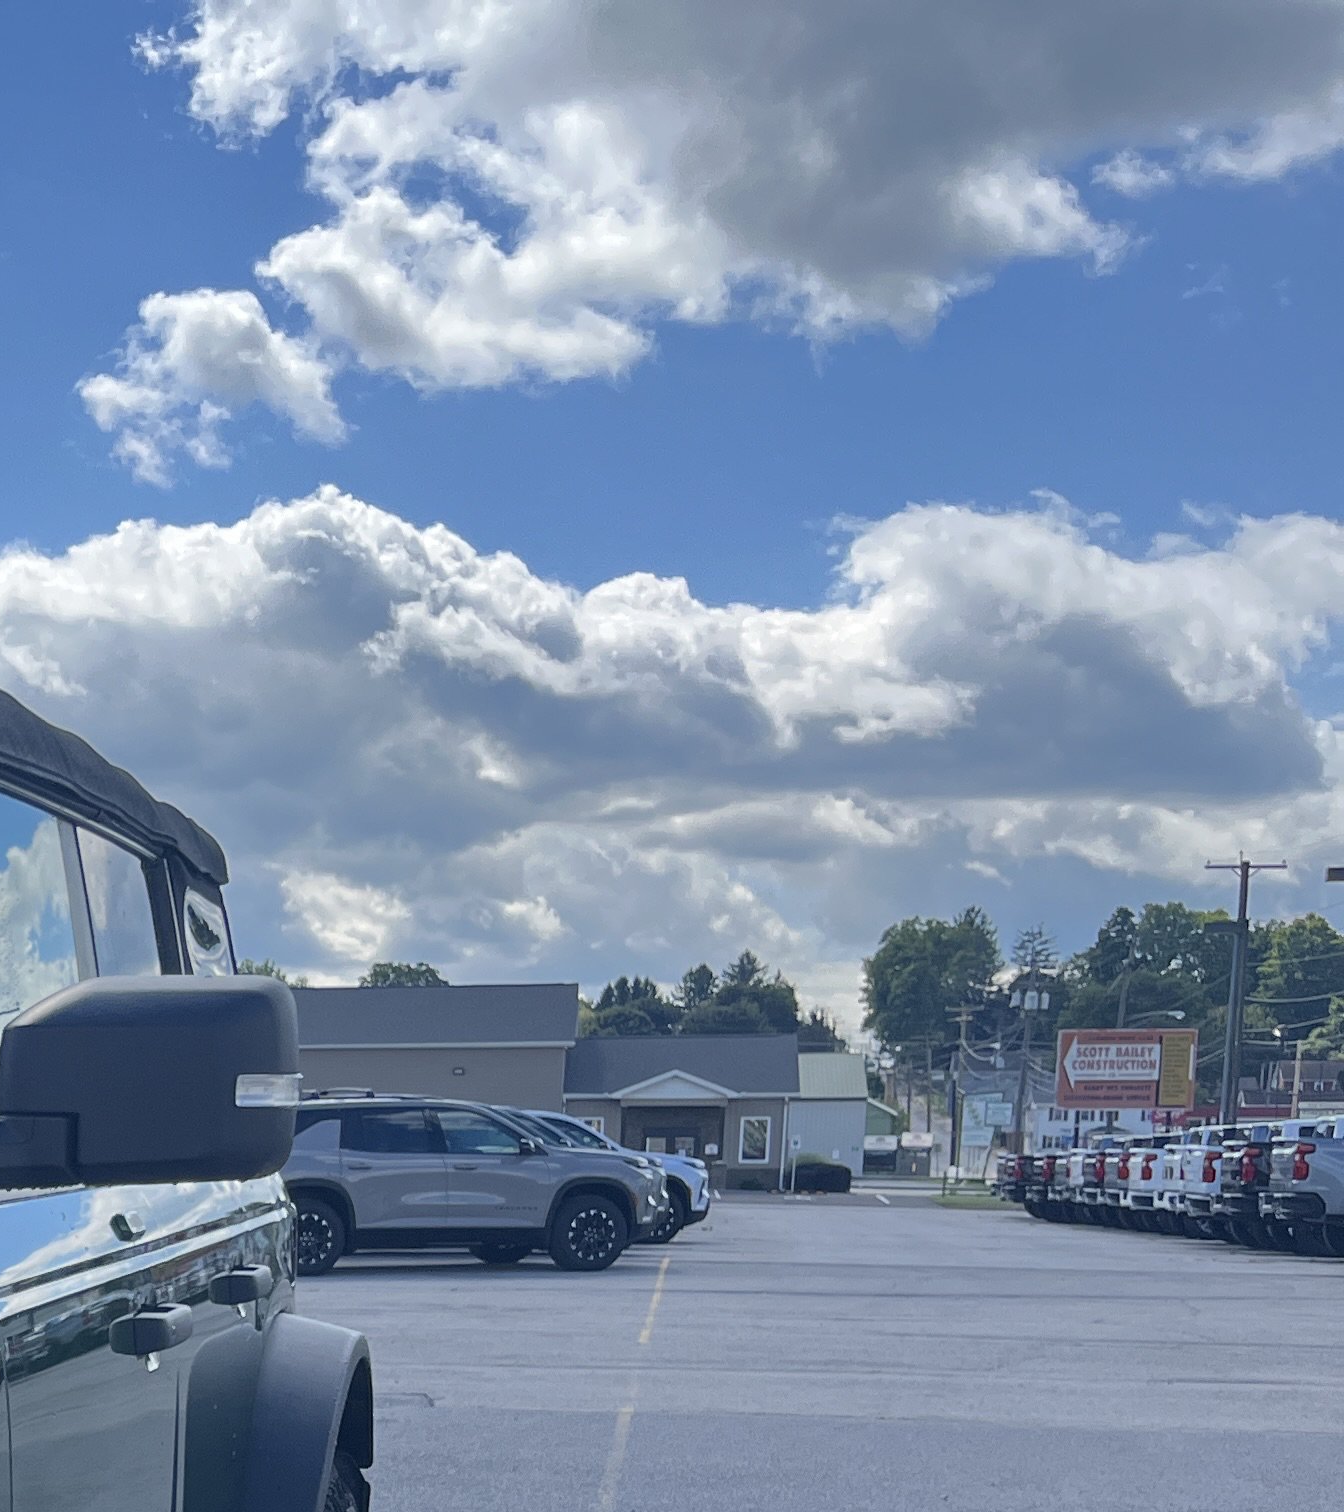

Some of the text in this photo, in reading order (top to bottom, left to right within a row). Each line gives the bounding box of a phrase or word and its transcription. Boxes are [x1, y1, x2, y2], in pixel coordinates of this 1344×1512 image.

[1075, 1046, 1155, 1058] SCOTT BAILEY
[1071, 1058, 1157, 1071] CONSTRUCTION
